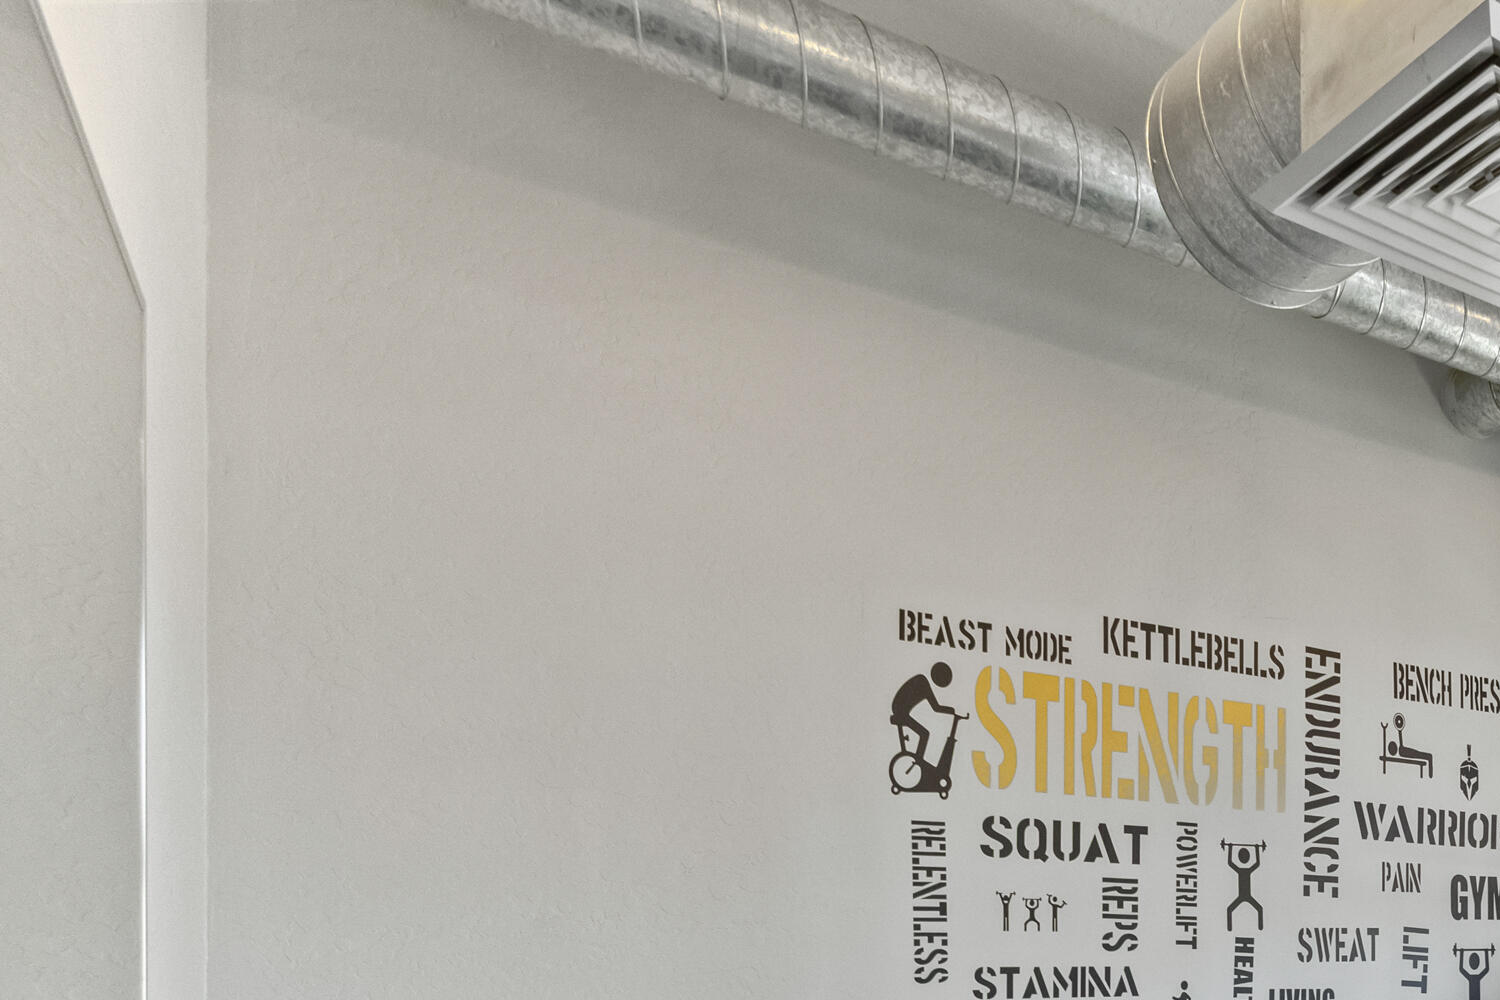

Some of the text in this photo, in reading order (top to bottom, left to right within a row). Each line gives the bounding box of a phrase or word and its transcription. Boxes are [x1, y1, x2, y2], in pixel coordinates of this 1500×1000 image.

[899, 608, 1072, 665] BEAST MODE
[1103, 616, 1284, 680] KETTLEBELLS
[1393, 662, 1452, 707] BENCH
[972, 665, 1286, 812] STRENGTH
[1303, 646, 1341, 898] ENDURANCE
[980, 816, 1148, 864] SQUAT
[911, 820, 948, 984] RELENTLESS
[1176, 822, 1198, 949] POWERLIFT
[1382, 862, 1421, 893] PAIN
[1102, 877, 1138, 951] REPS
[1297, 928, 1379, 962] SWEAT
[973, 966, 1139, 999] STAMINA
[1401, 927, 1429, 994] LIFT
